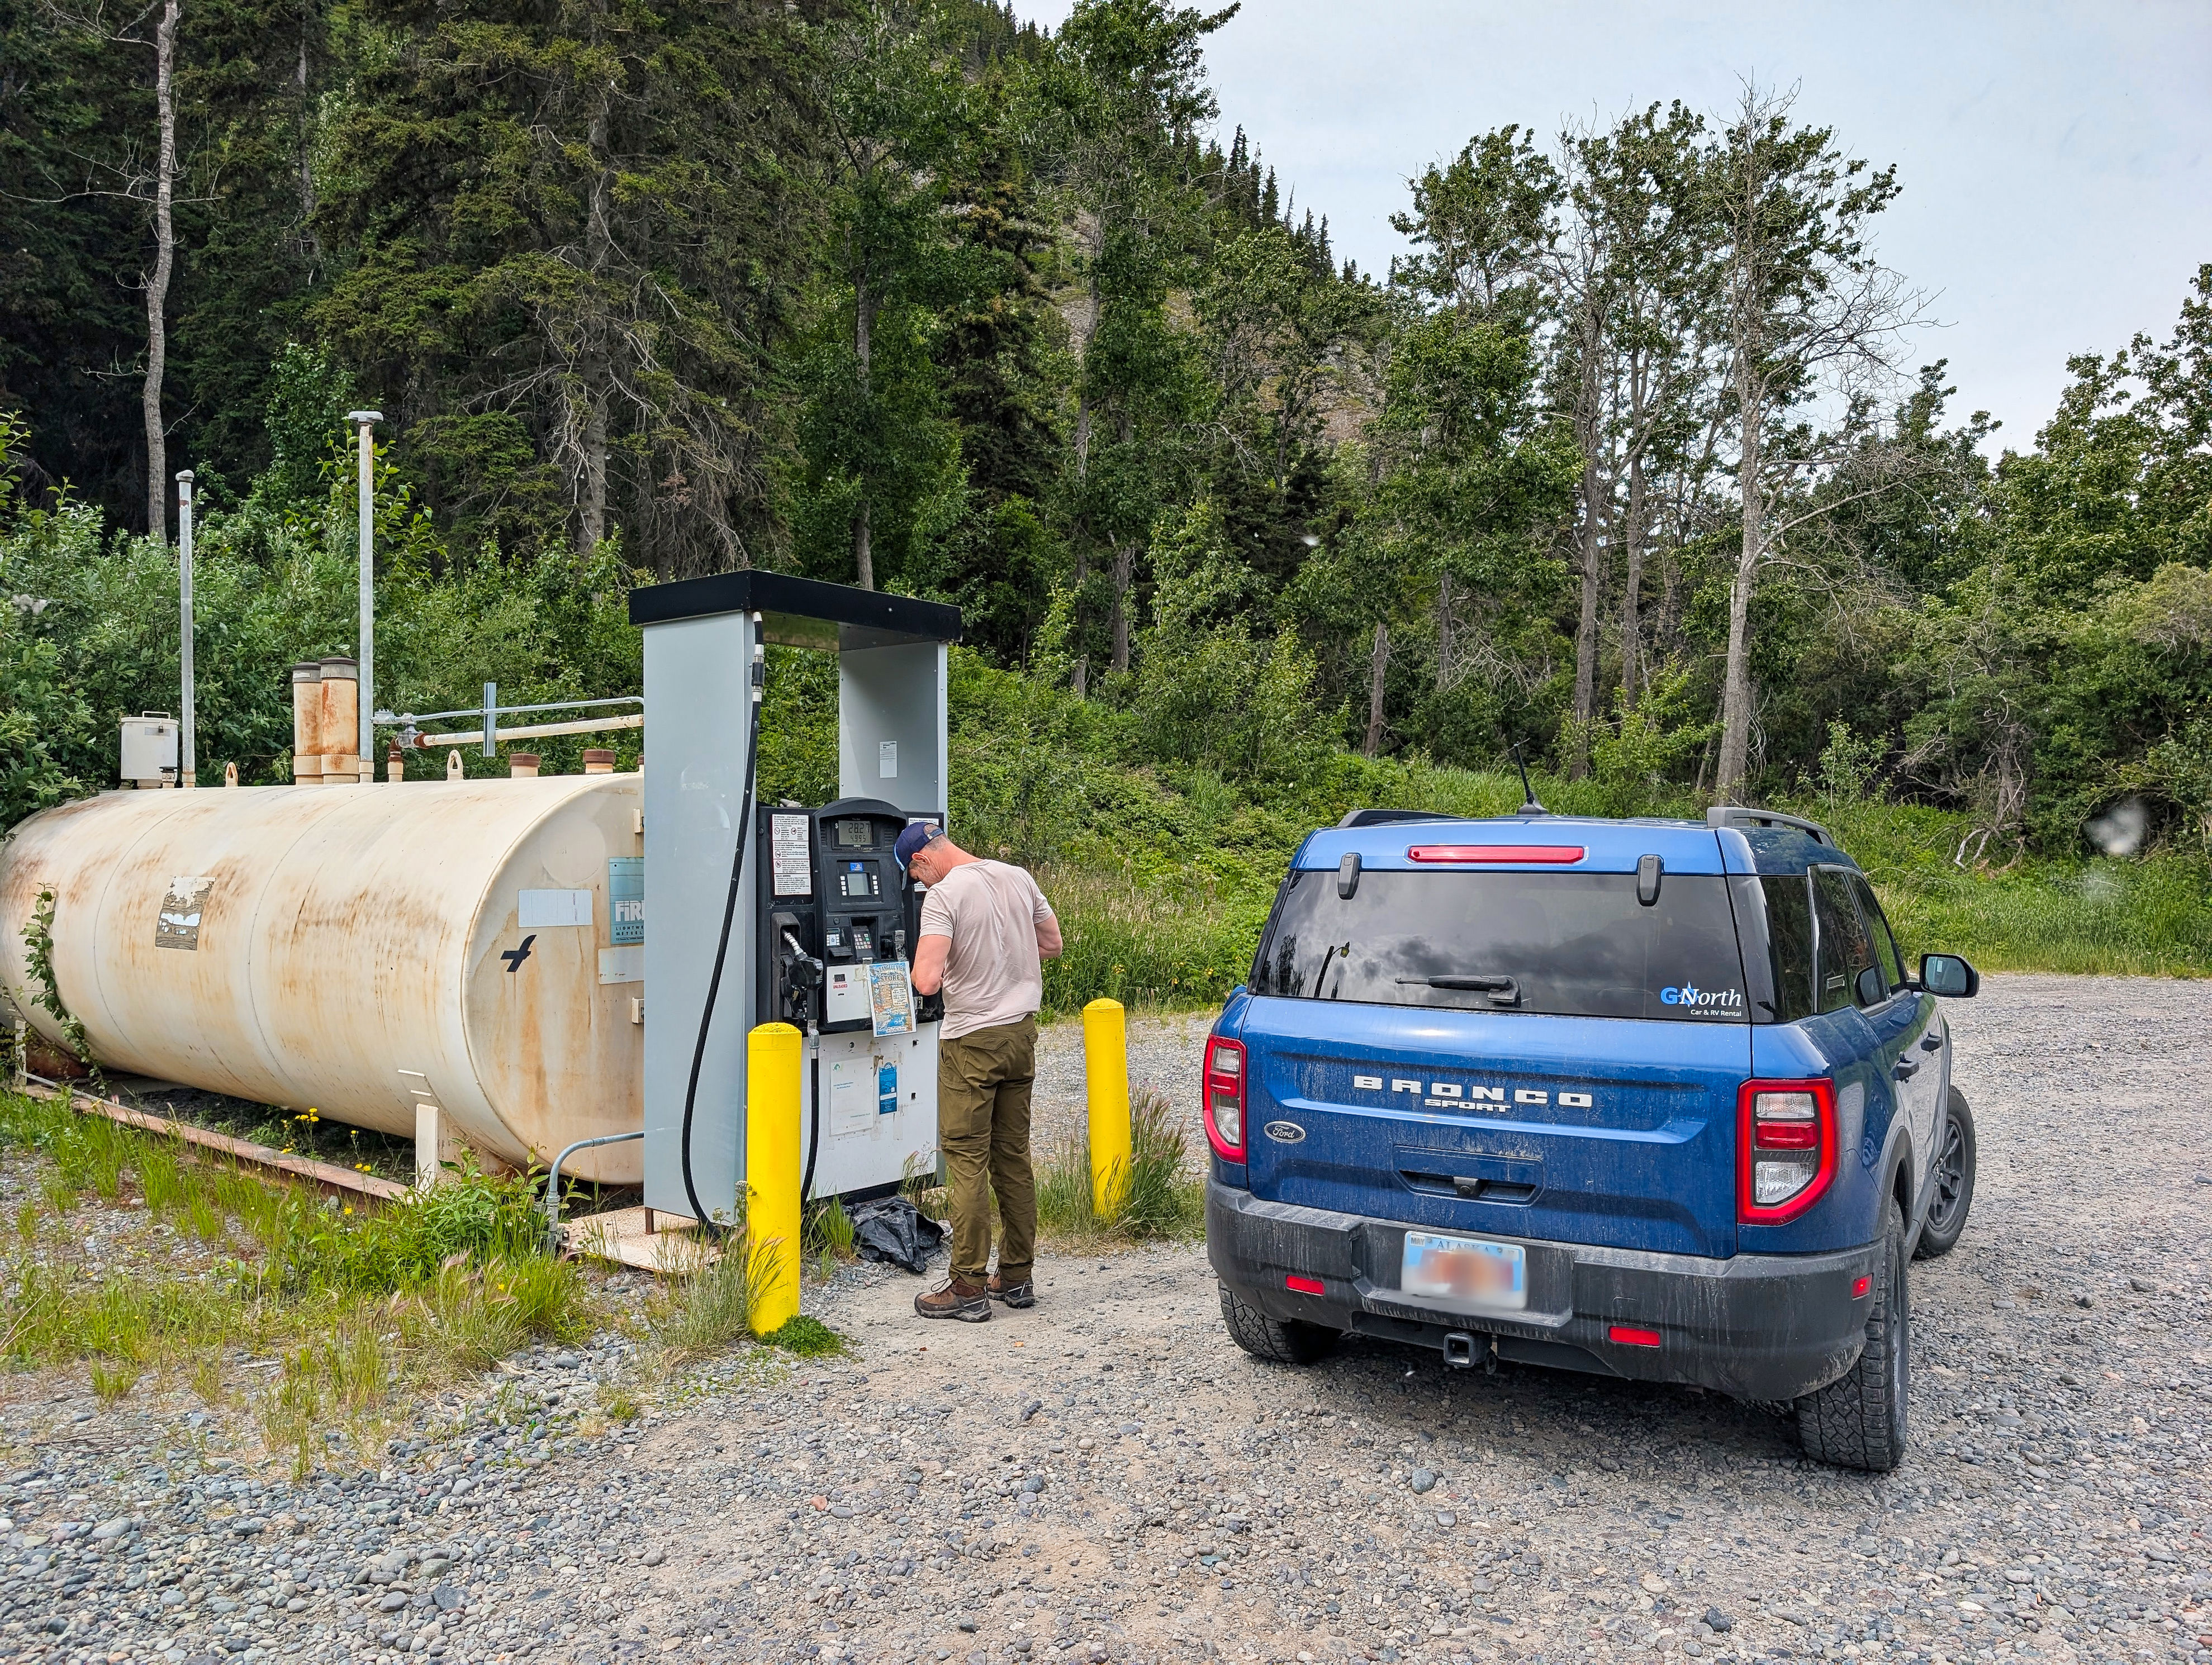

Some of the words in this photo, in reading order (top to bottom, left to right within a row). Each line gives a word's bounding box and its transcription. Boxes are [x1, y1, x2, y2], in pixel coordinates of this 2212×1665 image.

[1354, 1075, 1592, 1107] BRONCO
[1424, 1098, 1512, 1112] SPORT
[1273, 1125, 1295, 1138] Ford
[1411, 1236, 1425, 1245] MAY
